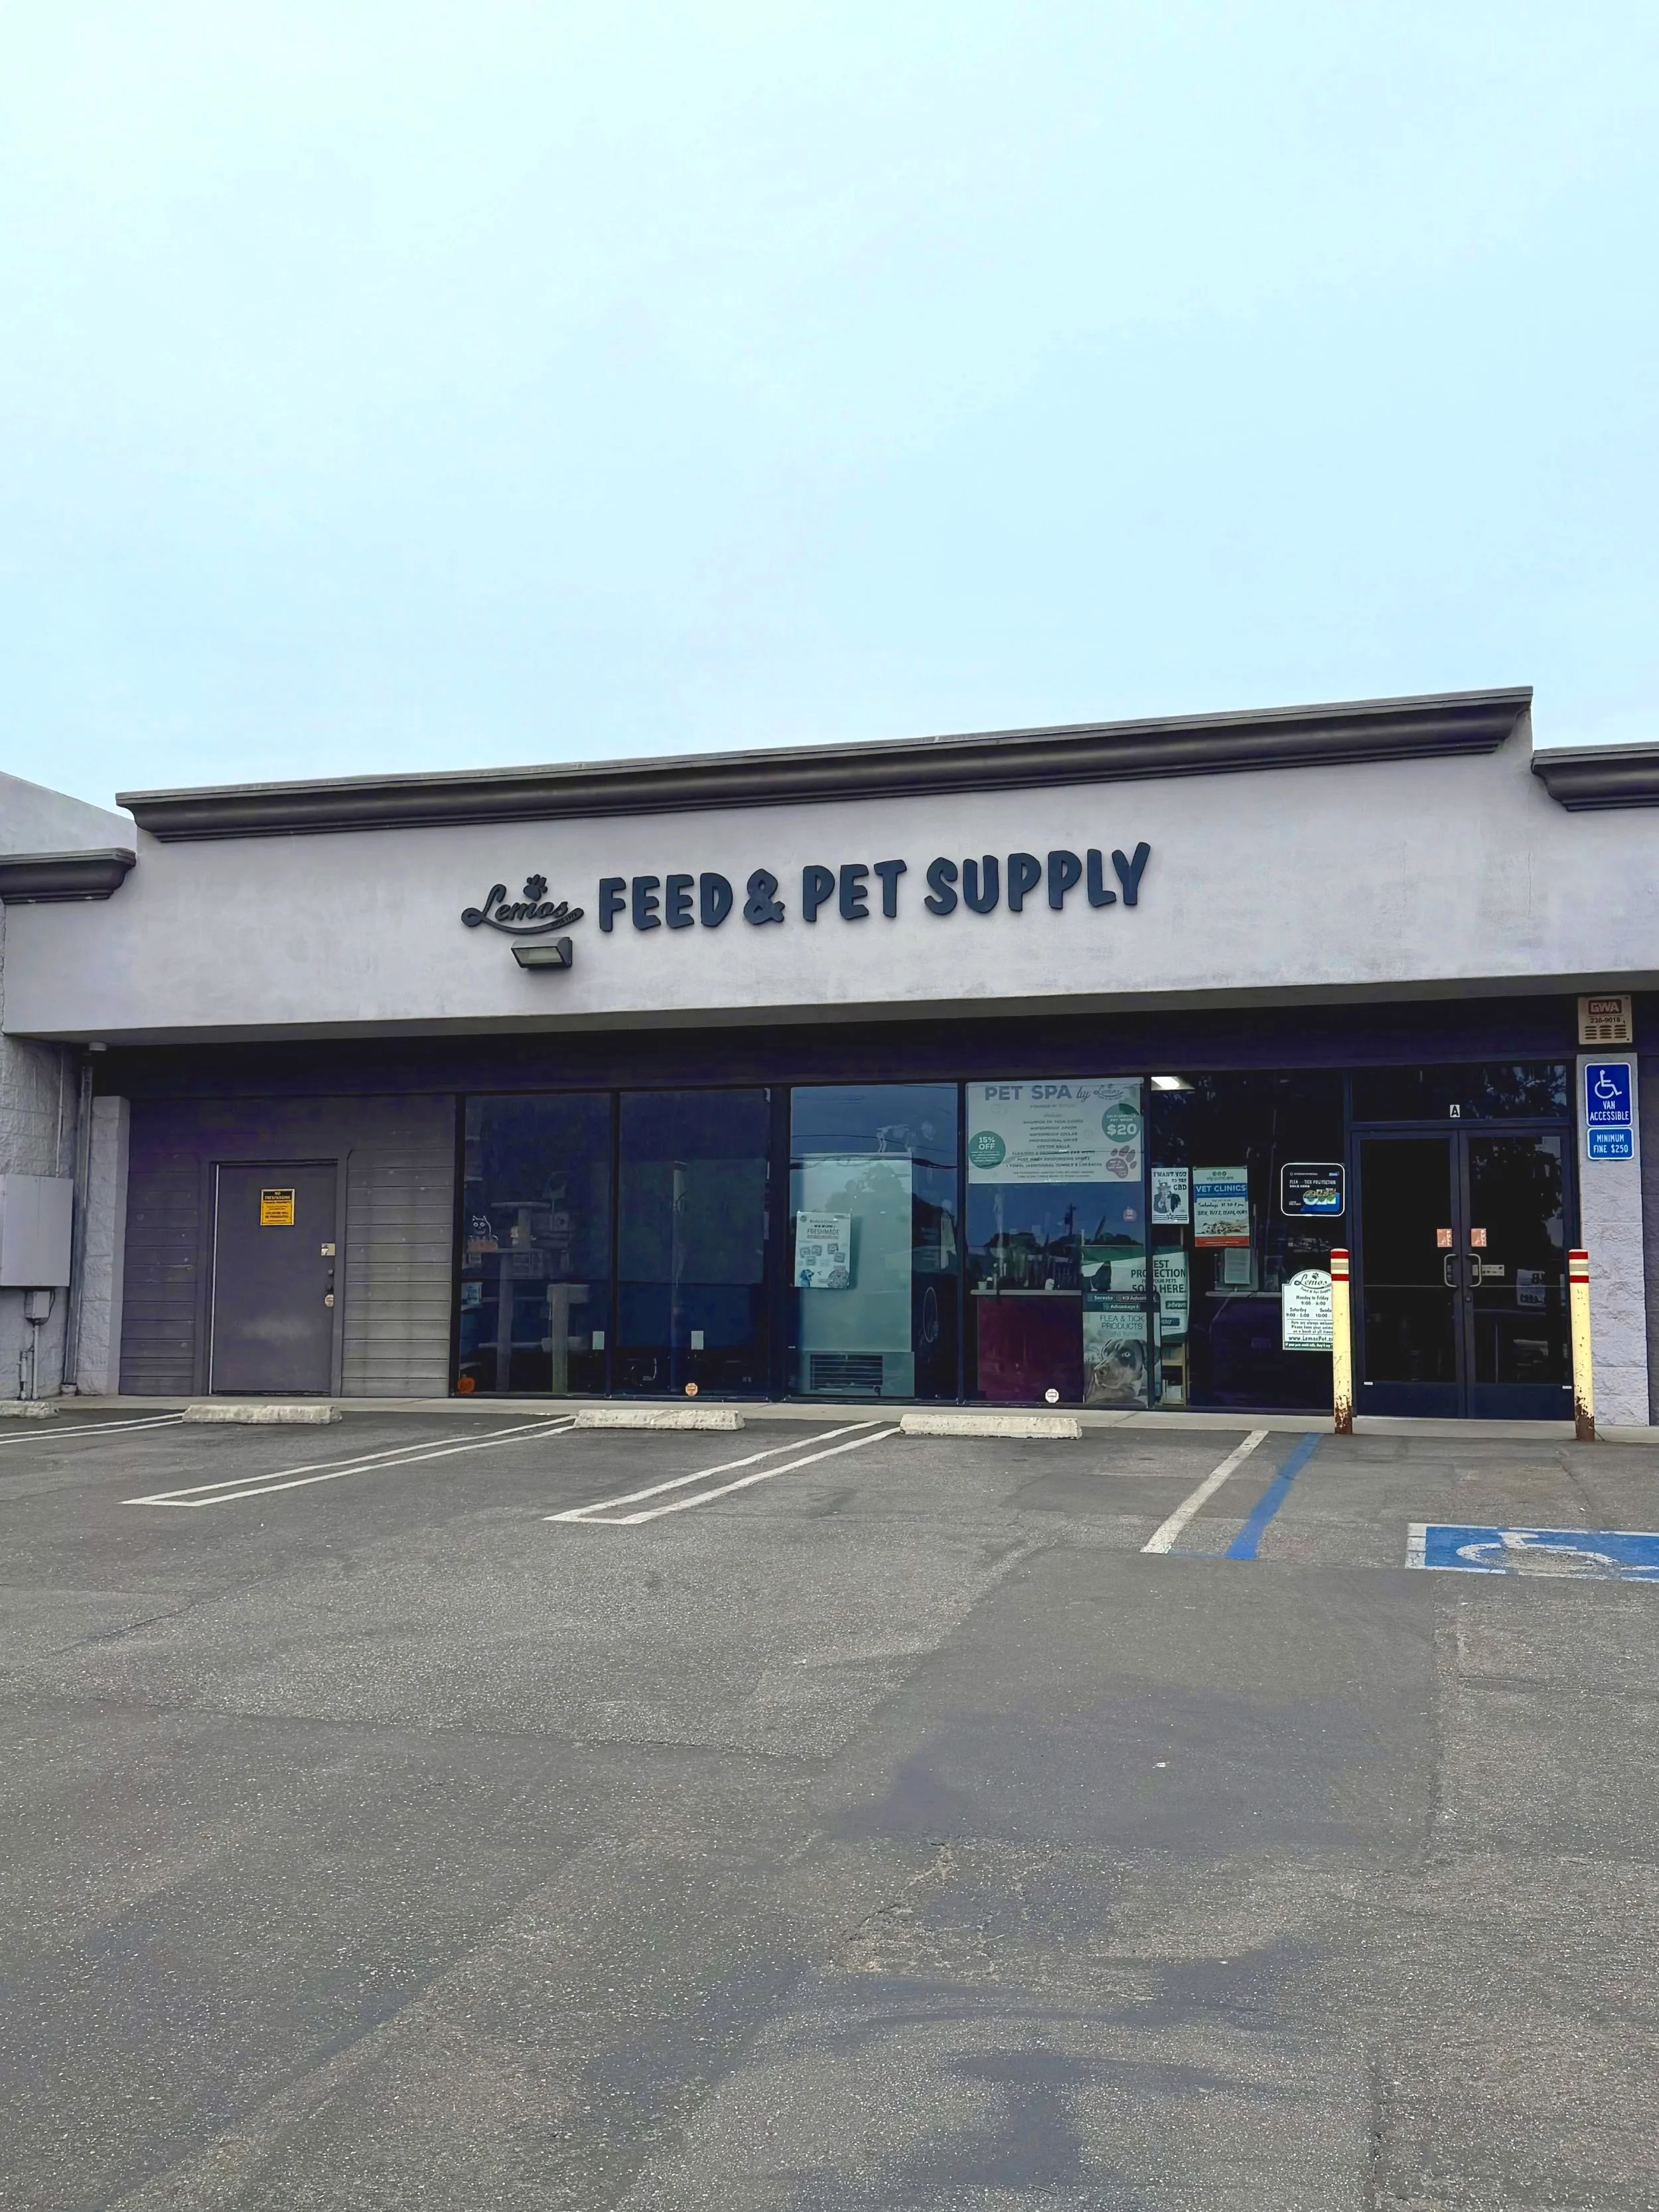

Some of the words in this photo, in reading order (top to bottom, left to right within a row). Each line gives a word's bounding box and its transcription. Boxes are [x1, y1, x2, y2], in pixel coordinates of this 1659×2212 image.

[599, 873, 733, 932] FEED
[743, 869, 786, 925] &
[802, 859, 908, 922] PET
[924, 842, 1151, 915] SUPPLY
[461, 883, 585, 935] Lemos
[985, 1086, 1023, 1101] PET
[1031, 1084, 1072, 1100] SPA
[1076, 1086, 1091, 1102] by
[1603, 1100, 1616, 1110] VAN
[1451, 1106, 1460, 1117] A
[1589, 1111, 1630, 1121] ACCESSIBLE
[1107, 1123, 1137, 1136] $20
[1593, 1145, 1607, 1153] FINE
[1611, 1144, 1629, 1153] $250
[1131, 1269, 1186, 1278] PROECTION
[1293, 1274, 1331, 1290] Lemos
[1159, 1284, 1187, 1293] HERE.
